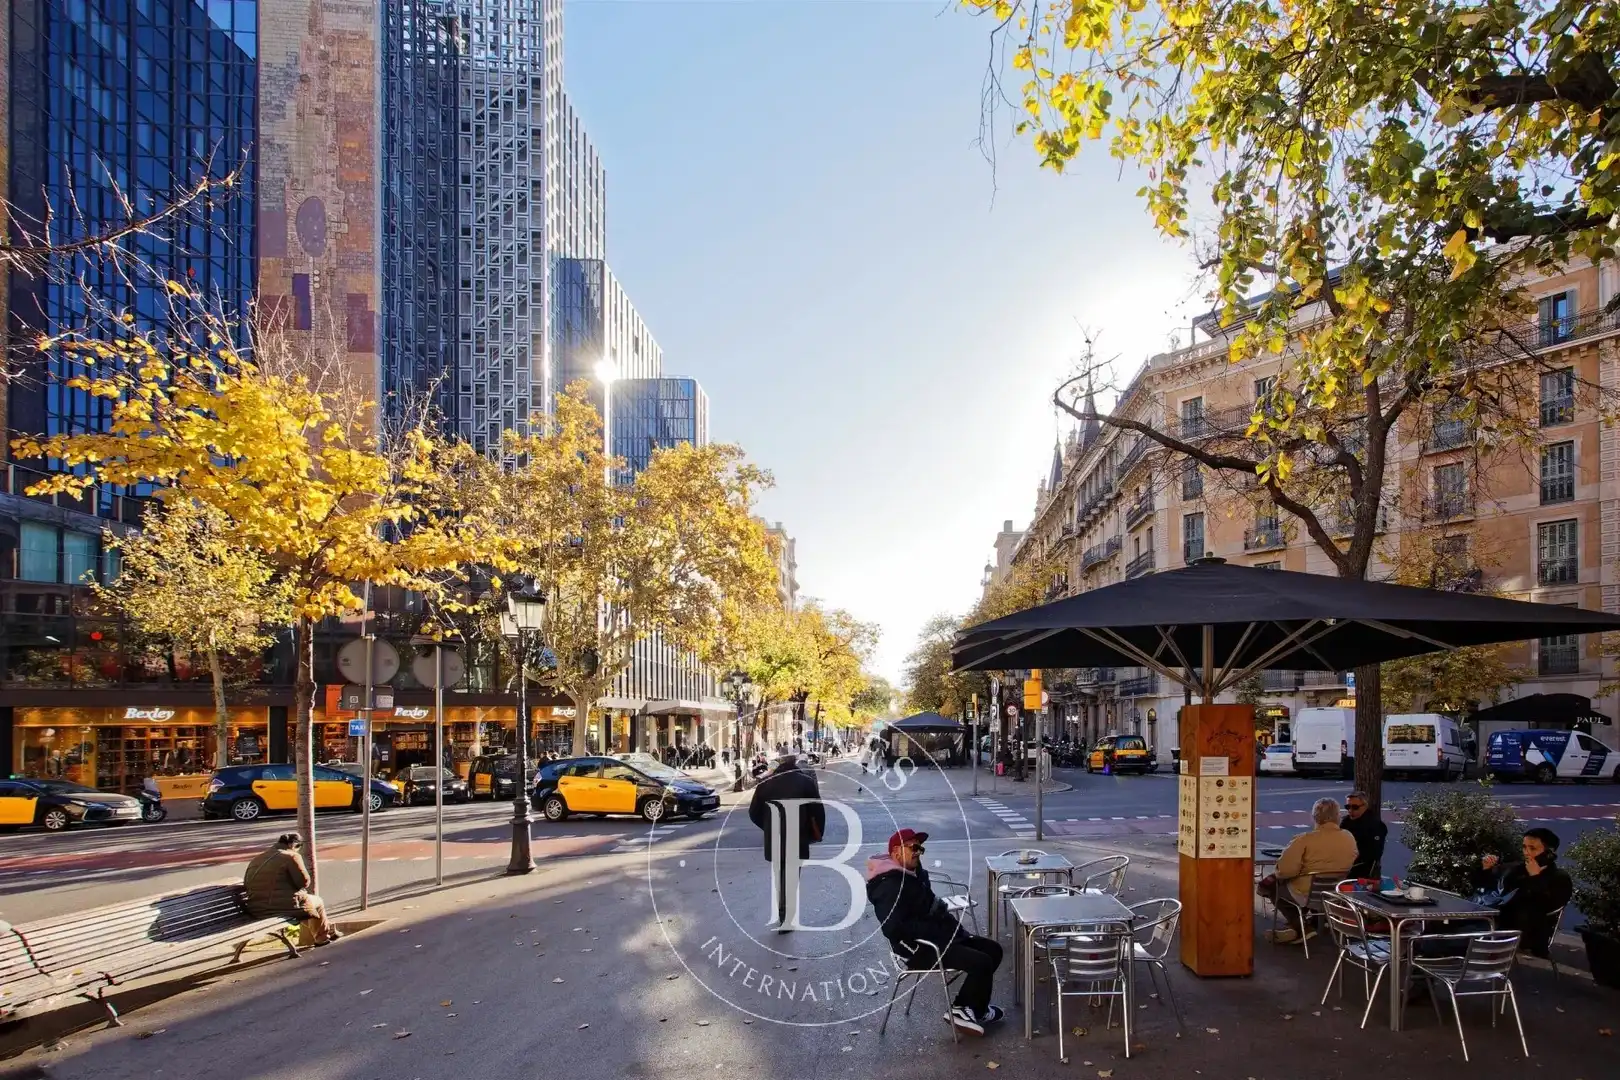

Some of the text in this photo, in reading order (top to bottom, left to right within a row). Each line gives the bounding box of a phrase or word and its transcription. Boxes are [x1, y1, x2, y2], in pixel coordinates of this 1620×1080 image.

[123, 707, 175, 722] Bexley
[394, 707, 429, 719] Bexley
[1576, 716, 1604, 724] PAUL
